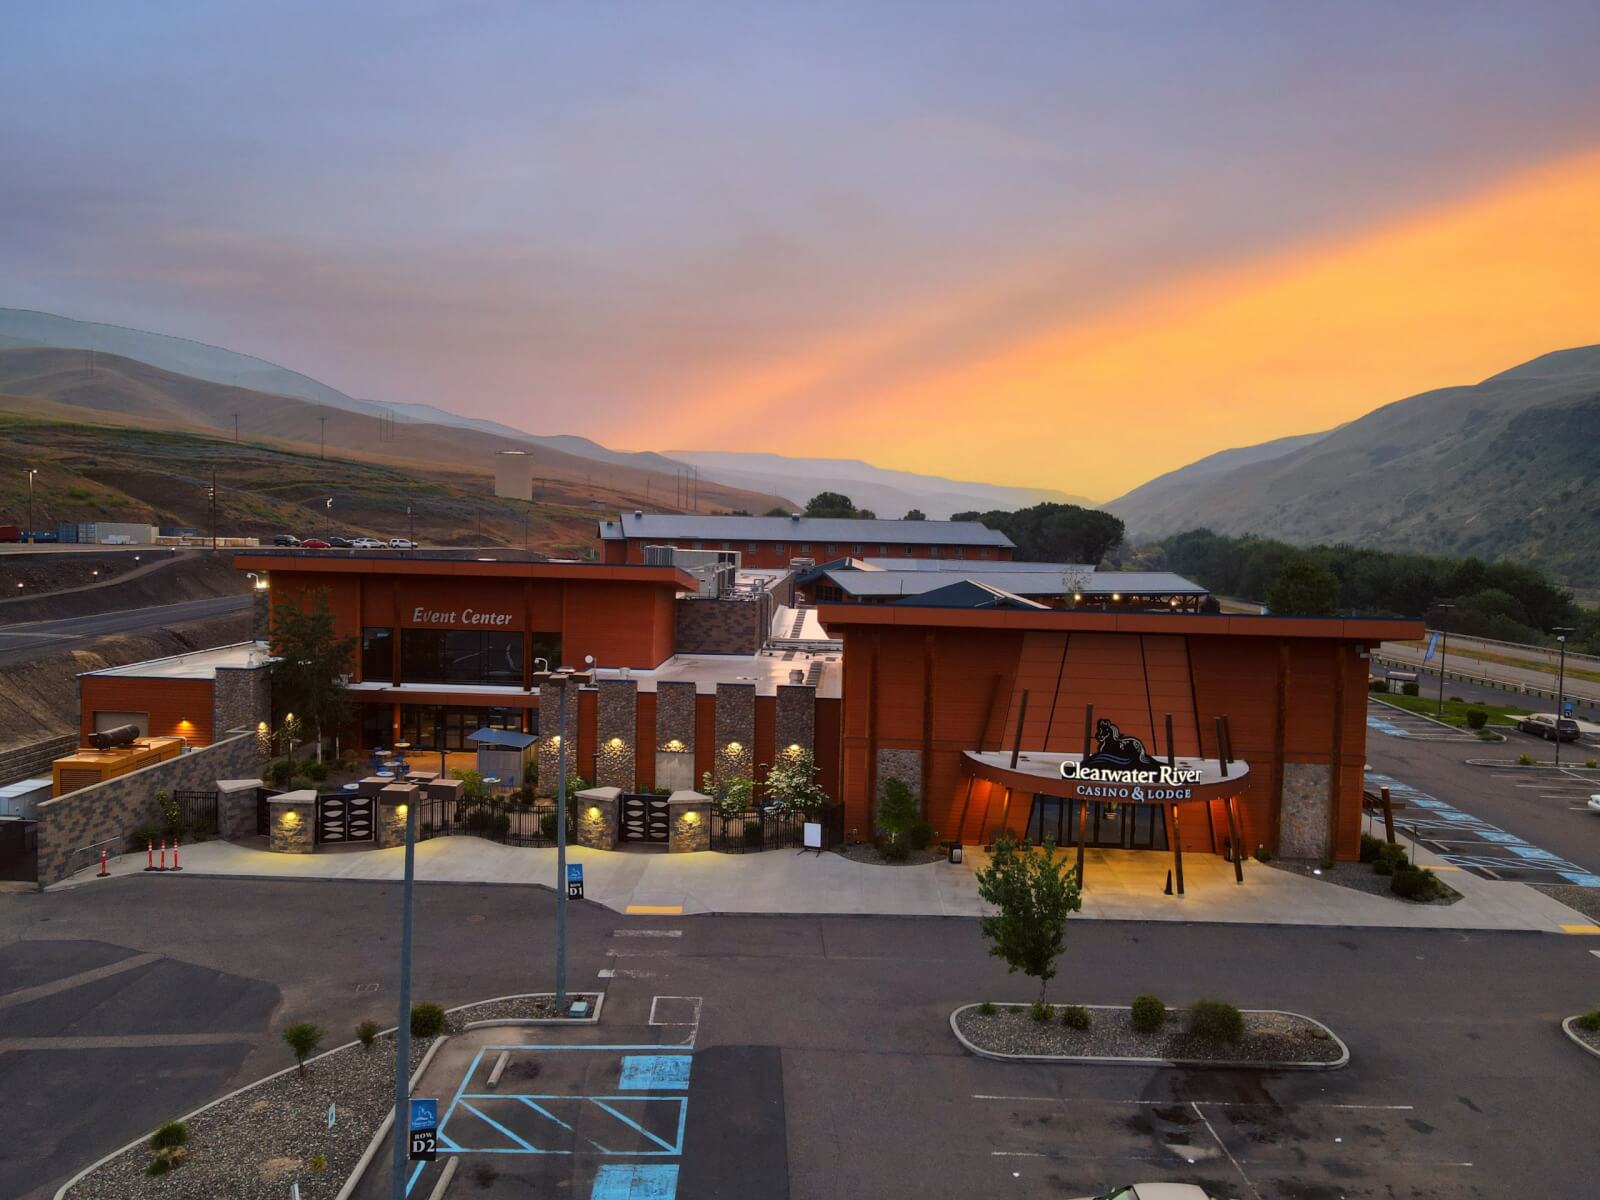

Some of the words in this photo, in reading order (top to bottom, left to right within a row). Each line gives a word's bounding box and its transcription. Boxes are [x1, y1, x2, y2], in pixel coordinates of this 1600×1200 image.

[412, 607, 456, 623] Event
[461, 608, 512, 624] Center
[1060, 760, 1158, 784] Clearwater
[1160, 766, 1203, 786] River
[1076, 785, 1128, 797] CASINO
[1148, 789, 1191, 799] LODGE
[570, 887, 583, 896] D1
[414, 1132, 432, 1140] ROW
[412, 1139, 435, 1153] D2
